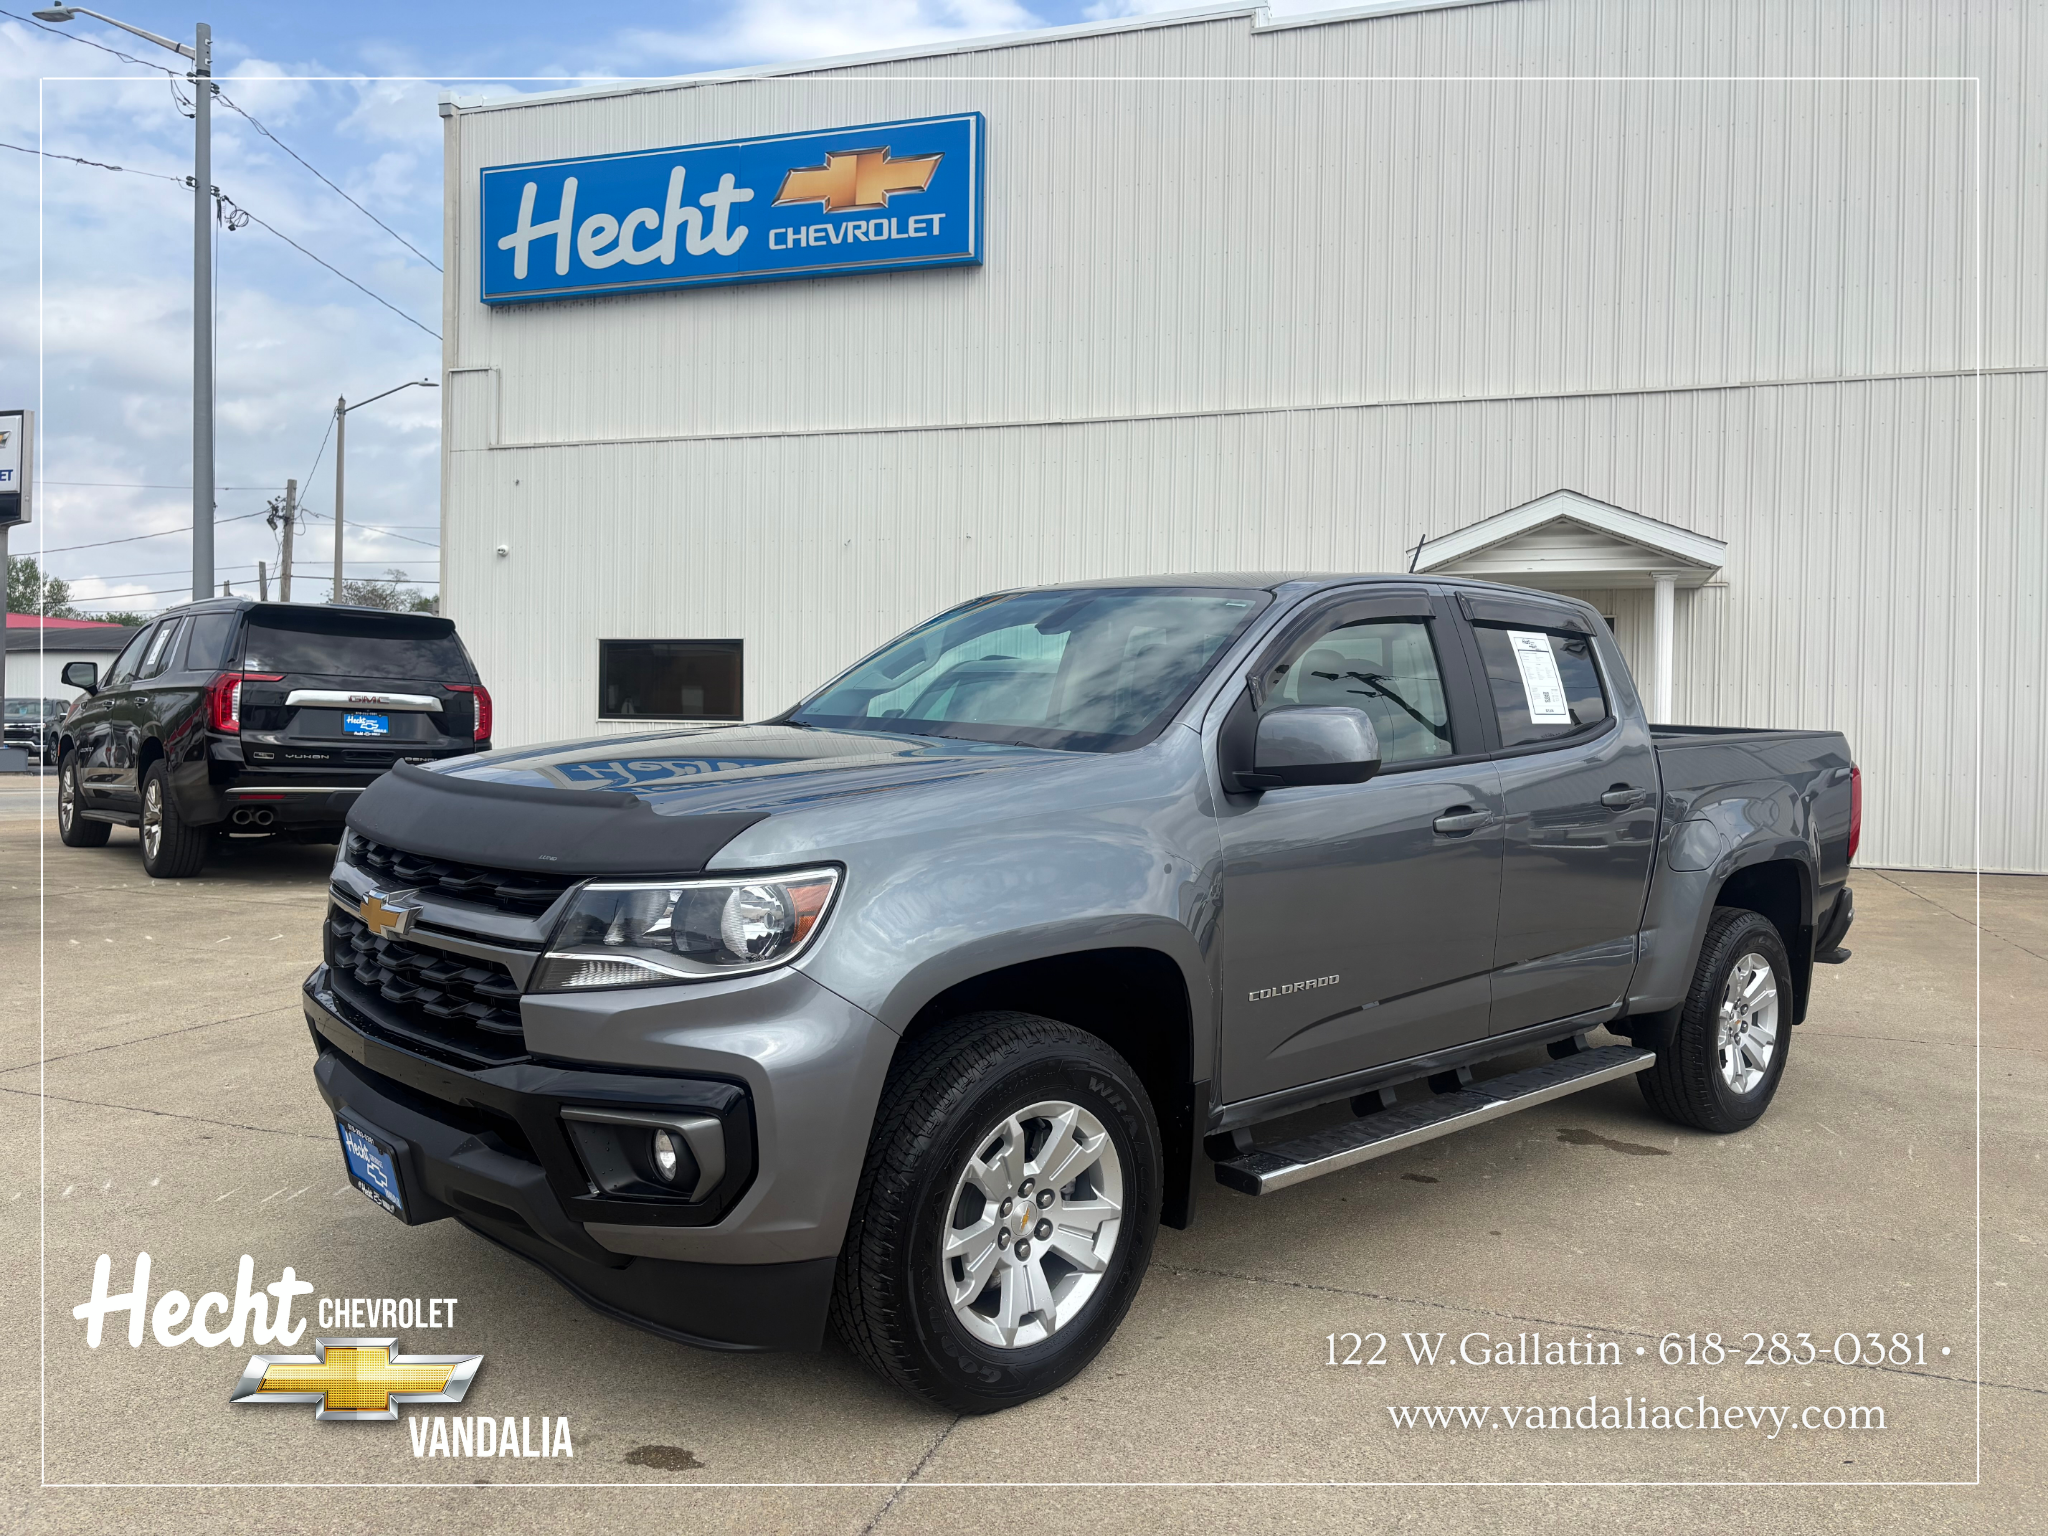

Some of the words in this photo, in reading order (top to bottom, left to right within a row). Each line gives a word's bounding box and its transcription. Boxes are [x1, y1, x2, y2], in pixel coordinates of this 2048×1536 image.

[497, 165, 755, 280] Hecht
[768, 213, 946, 250] CHEVROLET
[348, 695, 390, 704] GMC
[1248, 974, 1340, 1002] COLORADO
